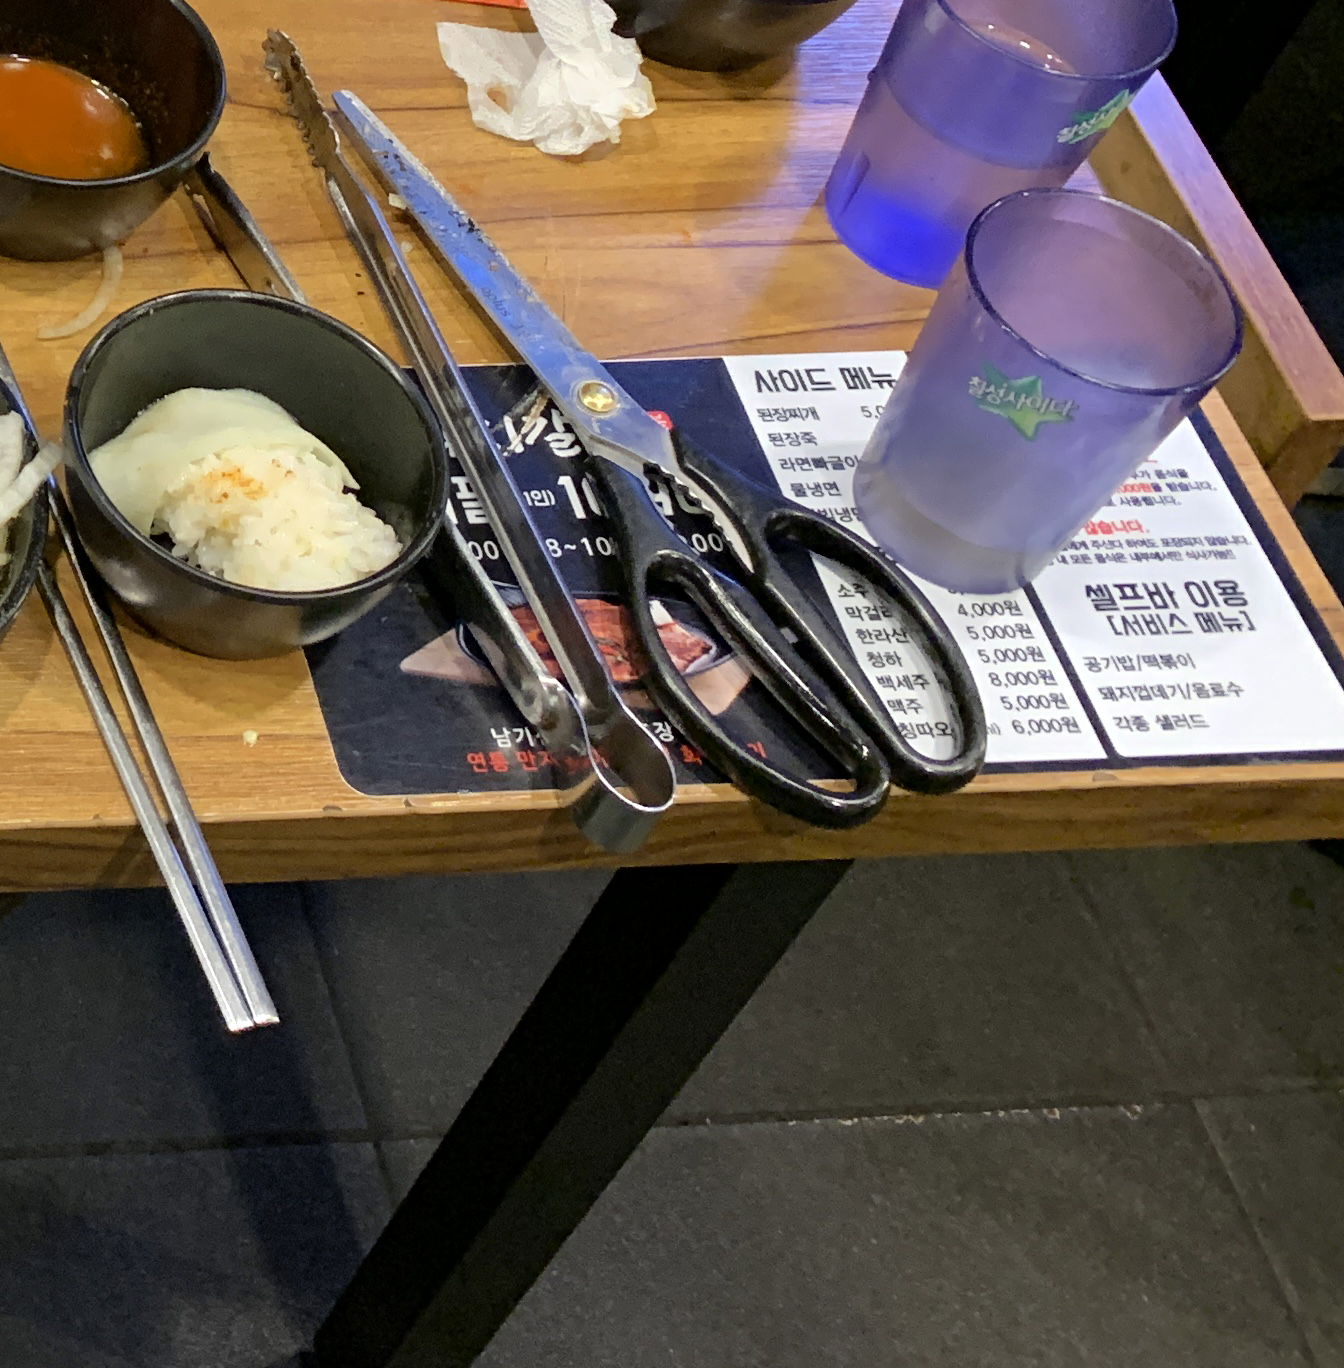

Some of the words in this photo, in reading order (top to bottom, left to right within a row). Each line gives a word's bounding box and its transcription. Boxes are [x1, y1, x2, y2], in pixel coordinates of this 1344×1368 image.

[753, 367, 836, 393] 사이드
[839, 366, 898, 390] 메뉴
[968, 376, 1079, 416] 칠성사이다
[757, 406, 821, 422] 된장찌개
[768, 432, 818, 447] 된장죽
[790, 482, 842, 498] 물냉면
[837, 583, 869, 599] 소주
[1085, 581, 1179, 612] 셀프바
[1184, 579, 1249, 608] 이용
[958, 600, 1024, 618] 4,000원
[857, 627, 910, 644] 한라산
[967, 623, 1035, 642] 5,000원
[1107, 613, 1194, 637] [서비스
[1194, 610, 1257, 633] 메뉴]
[868, 651, 903, 669] 청하
[977, 646, 1047, 665] 5,000원
[1083, 653, 1197, 673] 공기밥/떡볶이
[876, 673, 930, 692] 백세주
[989, 669, 1059, 688] 8,000원
[1097, 681, 1246, 703] 돼지껍데기/음료수
[887, 698, 924, 716] 맥주
[1000, 692, 1070, 712] 5,000원
[1012, 717, 1081, 736] 6,000원
[1112, 715, 1151, 733] 각종
